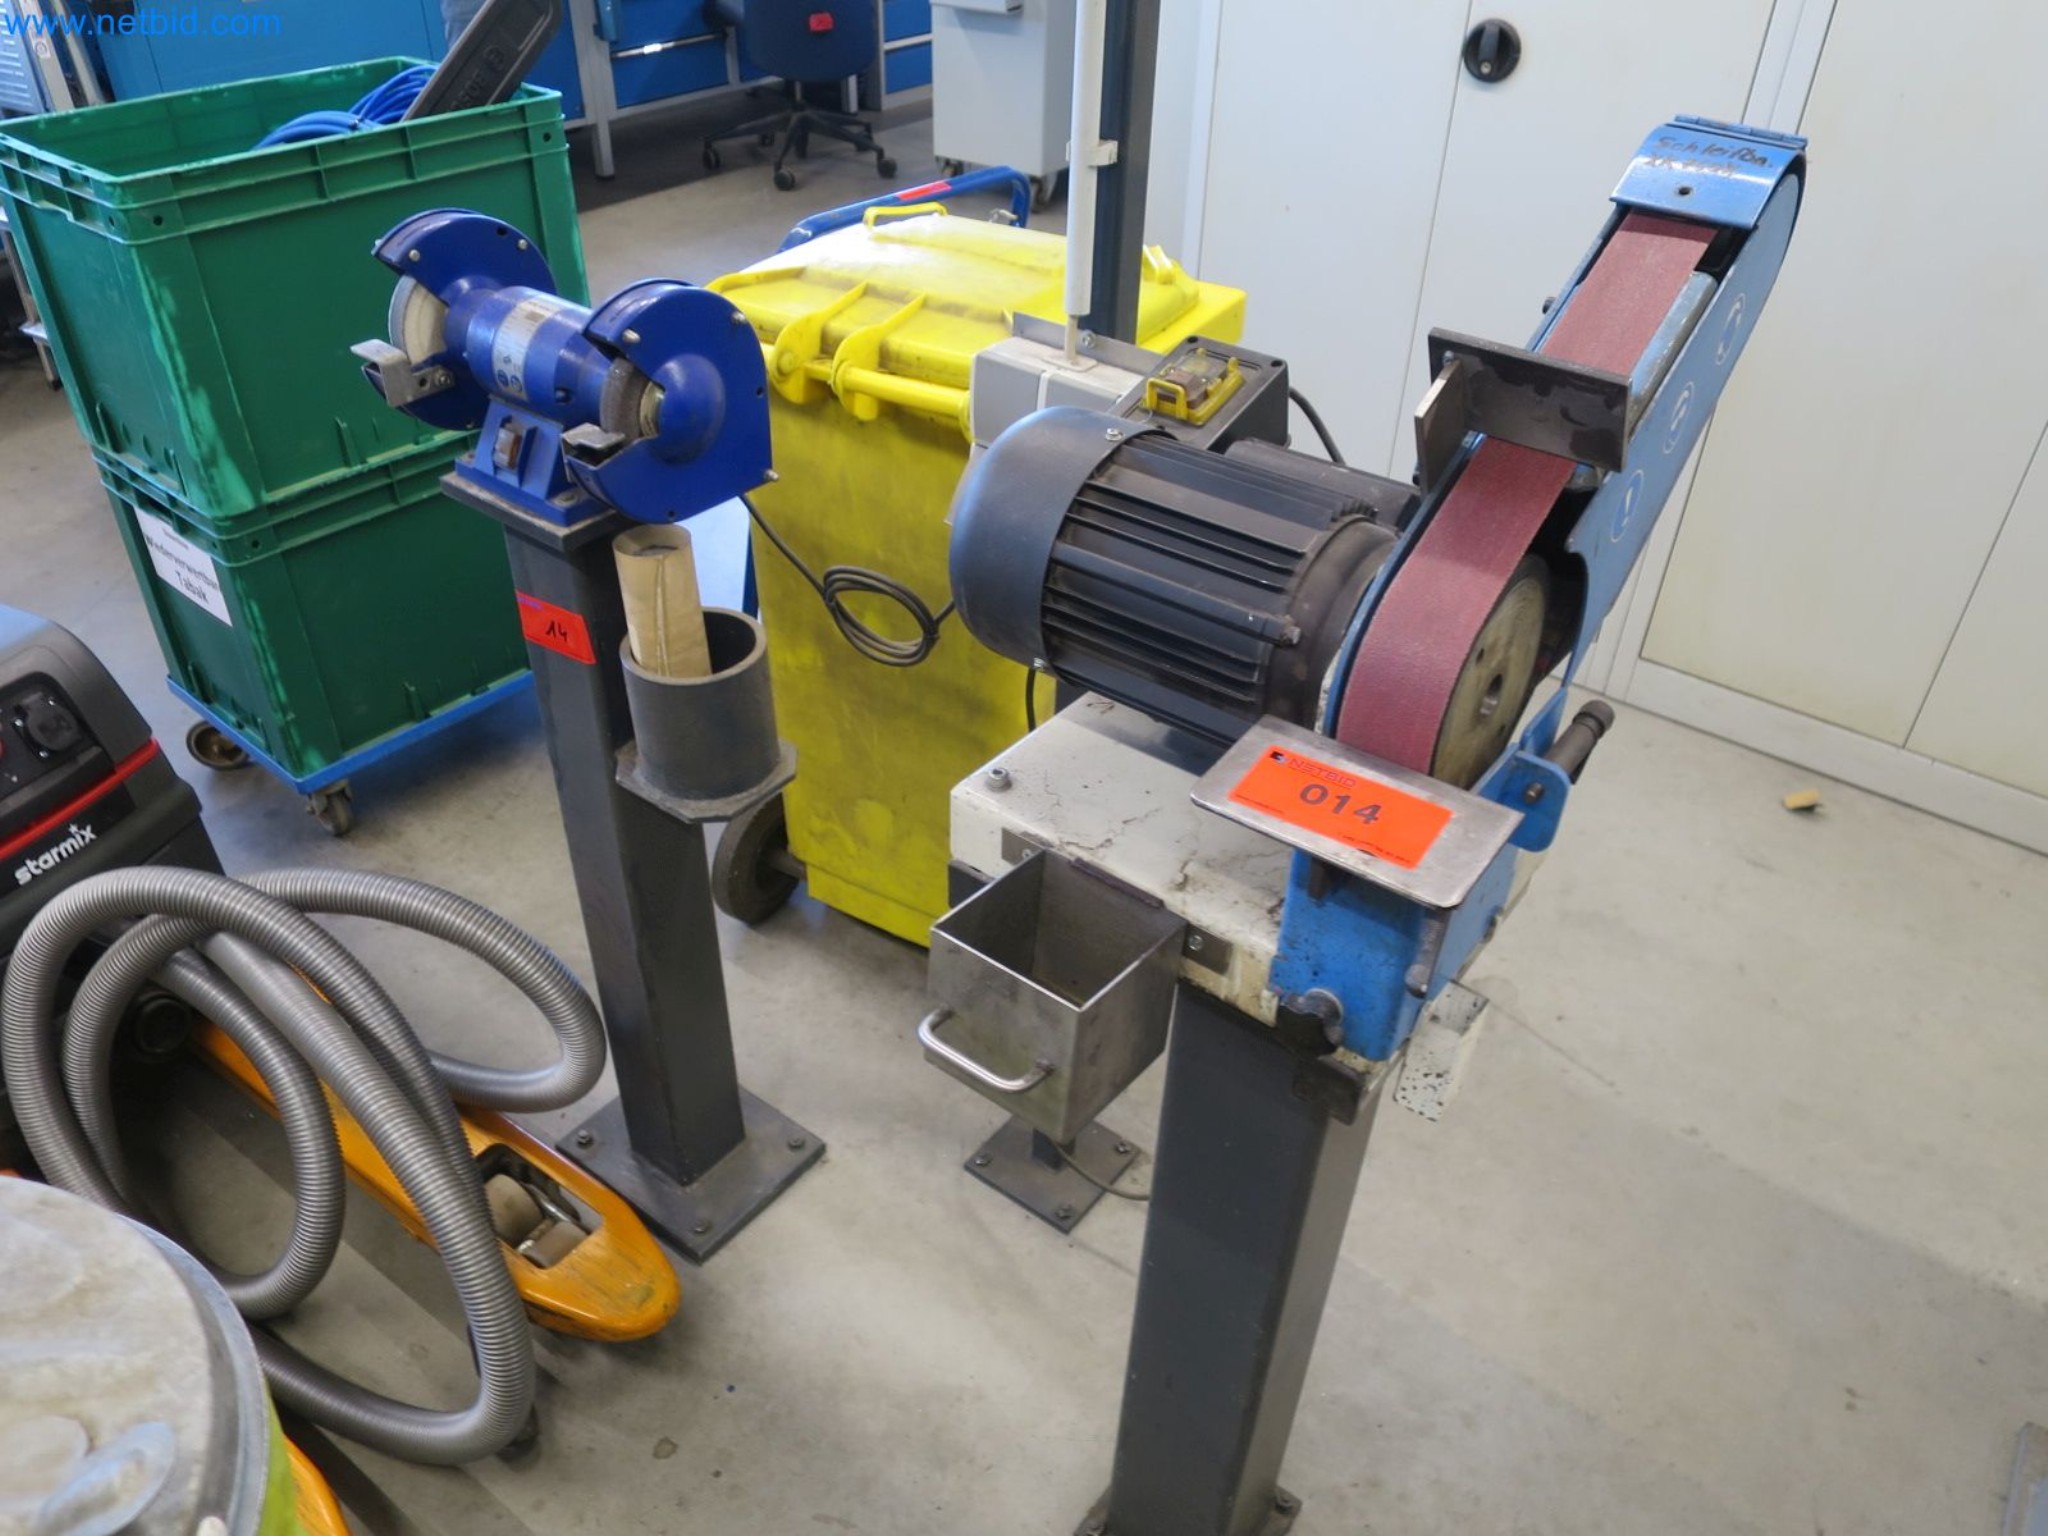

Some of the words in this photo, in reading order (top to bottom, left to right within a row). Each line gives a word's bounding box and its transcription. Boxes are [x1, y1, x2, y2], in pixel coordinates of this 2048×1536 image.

[545, 620, 568, 643] 14
[1289, 758, 1357, 788] NETBID
[1300, 783, 1382, 825] 014
[14, 823, 97, 886] starmix
